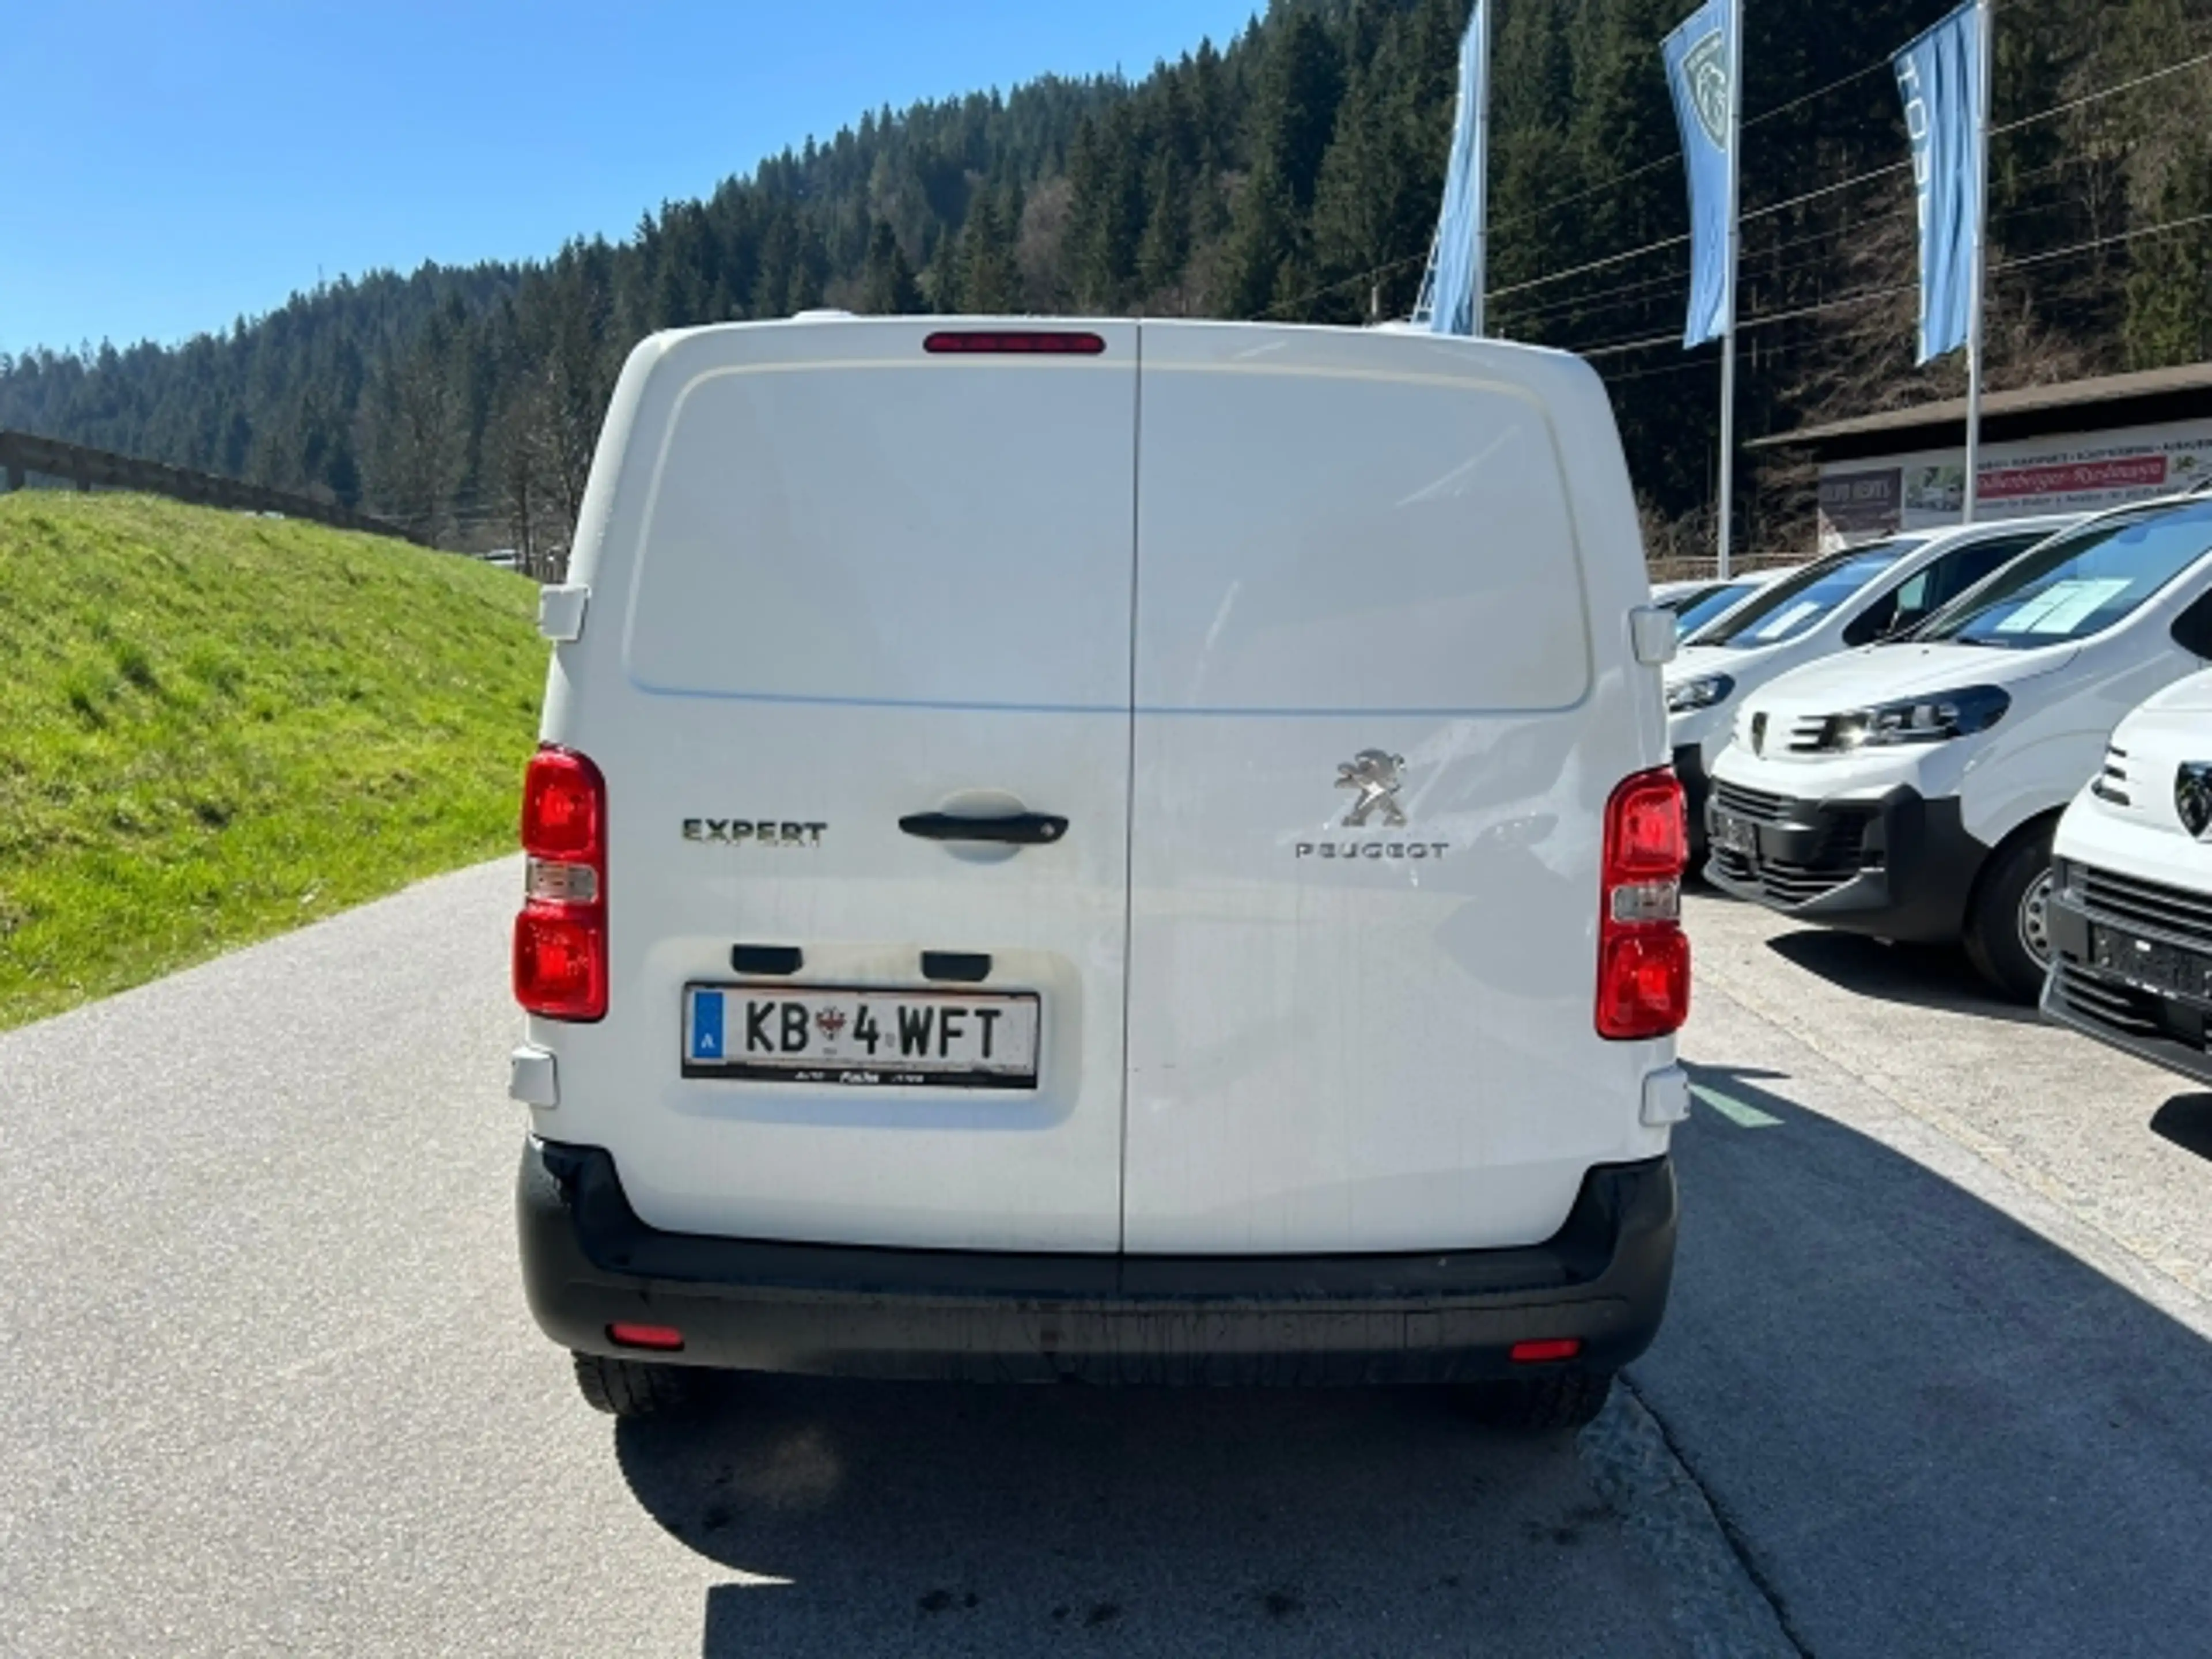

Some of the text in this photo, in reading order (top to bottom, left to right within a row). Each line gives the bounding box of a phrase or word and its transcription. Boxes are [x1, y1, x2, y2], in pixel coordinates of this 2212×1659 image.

[682, 817, 828, 842] EXPERT
[1295, 842, 1449, 859] PEUGEOT
[746, 1001, 1002, 1059] KB 4 WFT
